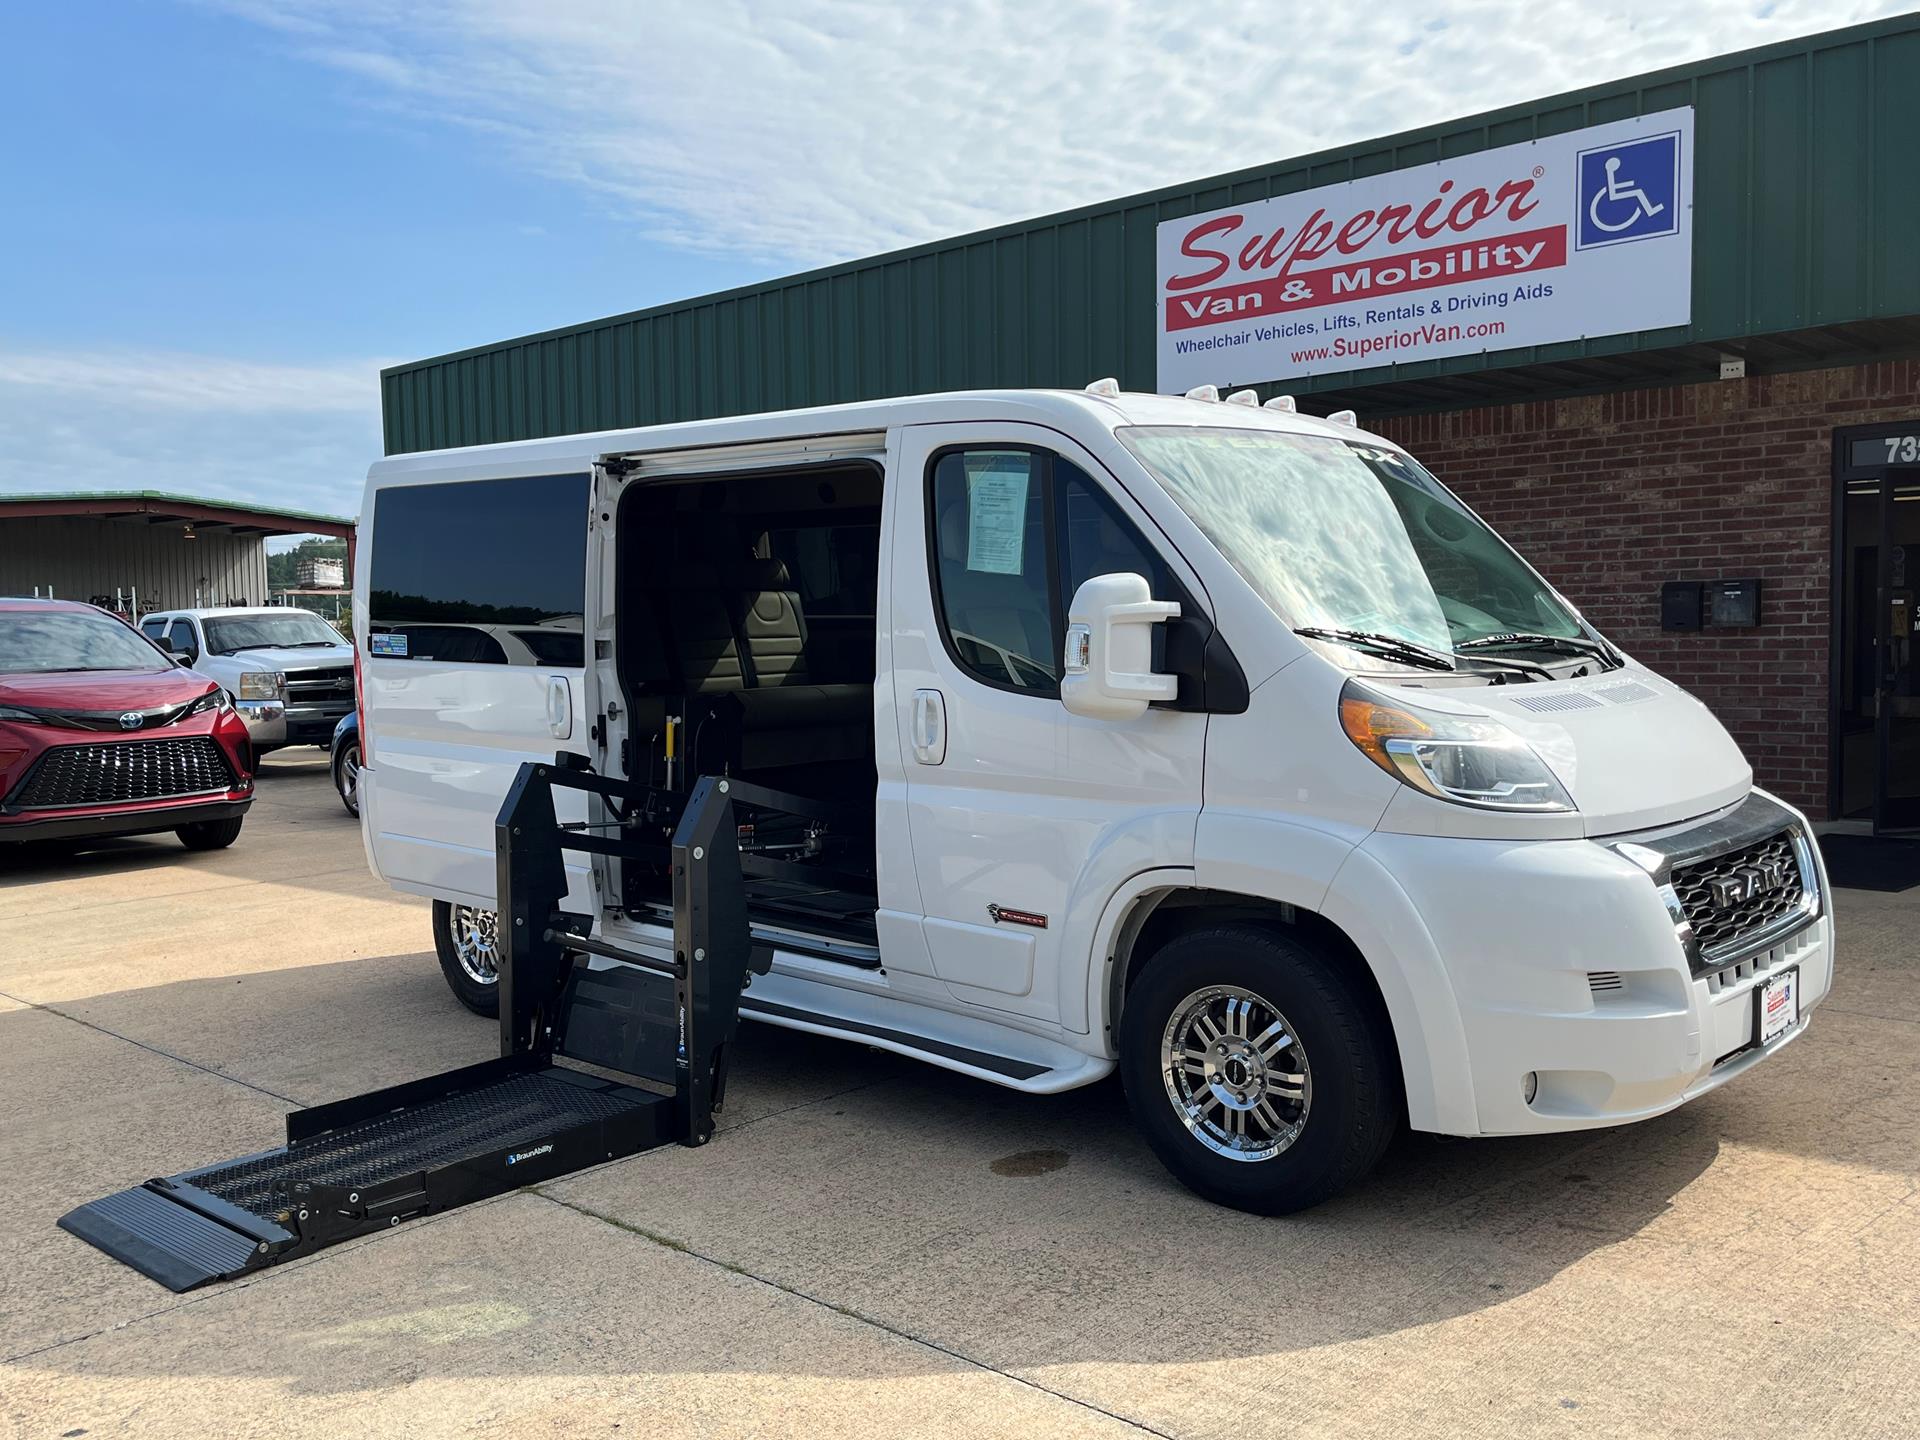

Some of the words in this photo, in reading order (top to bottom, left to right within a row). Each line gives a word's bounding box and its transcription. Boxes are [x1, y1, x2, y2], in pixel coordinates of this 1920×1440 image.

[1166, 179, 1540, 291] Superior
[1180, 293, 1263, 319] Van
[1280, 279, 1314, 302] &
[1332, 241, 1546, 294] Mobility
[1175, 331, 1251, 354] Wheelchair
[1254, 322, 1319, 342] Vehicles,
[1323, 314, 1361, 331] Lifts,
[1366, 304, 1425, 324] Rentals
[1430, 299, 1443, 314] &
[1447, 291, 1508, 311] Driving
[1513, 283, 1554, 301] Aids
[1290, 321, 1505, 363] www.SuperiorVan.com
[1710, 859, 1783, 908] RAM
[516, 1144, 554, 1162] BraunAbility
